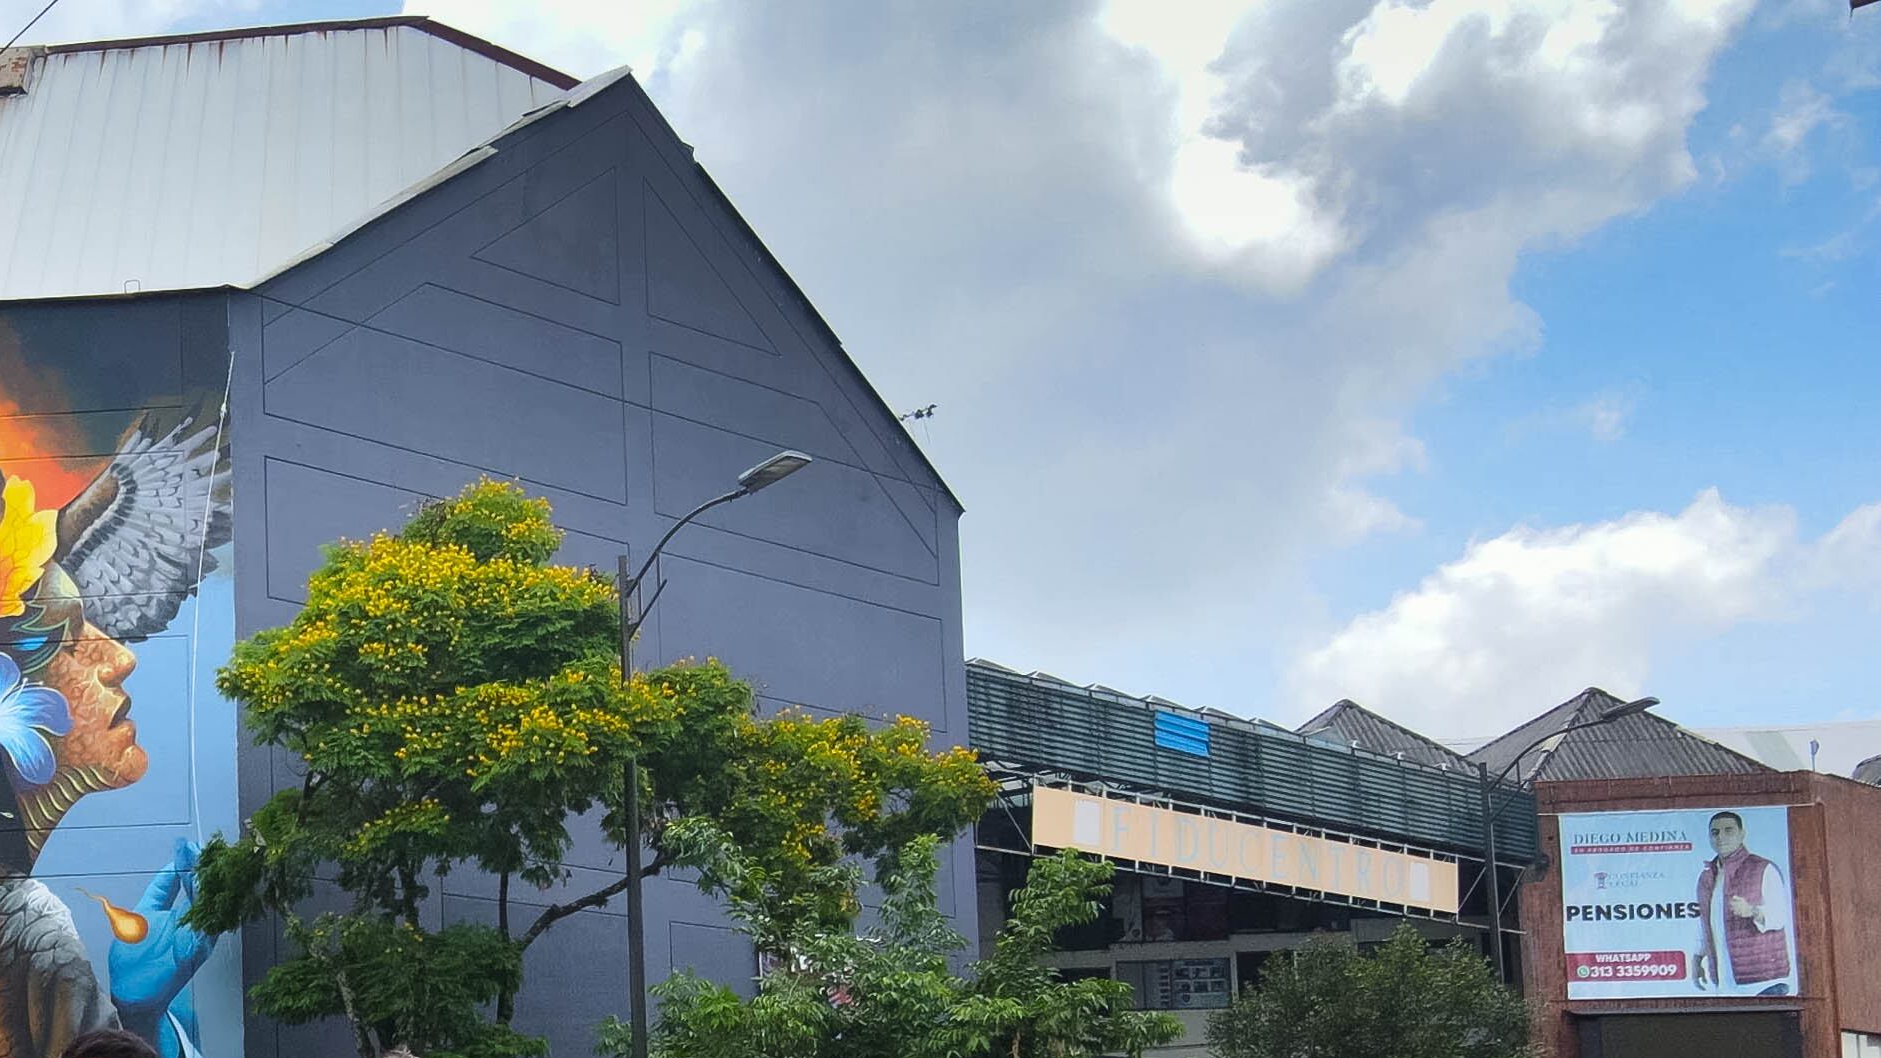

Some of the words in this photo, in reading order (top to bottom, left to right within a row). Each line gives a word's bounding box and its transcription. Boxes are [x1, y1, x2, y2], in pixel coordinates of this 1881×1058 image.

[1574, 833, 1620, 844] DIEGO
[1626, 830, 1687, 842] MEDINA
[1112, 806, 1405, 898] FIDUCENTRO
[1566, 902, 1701, 921] PENSIONES
[1595, 953, 1652, 963] WHATSAPP
[1590, 965, 1613, 977] 313
[1616, 964, 1677, 977] 3359909
